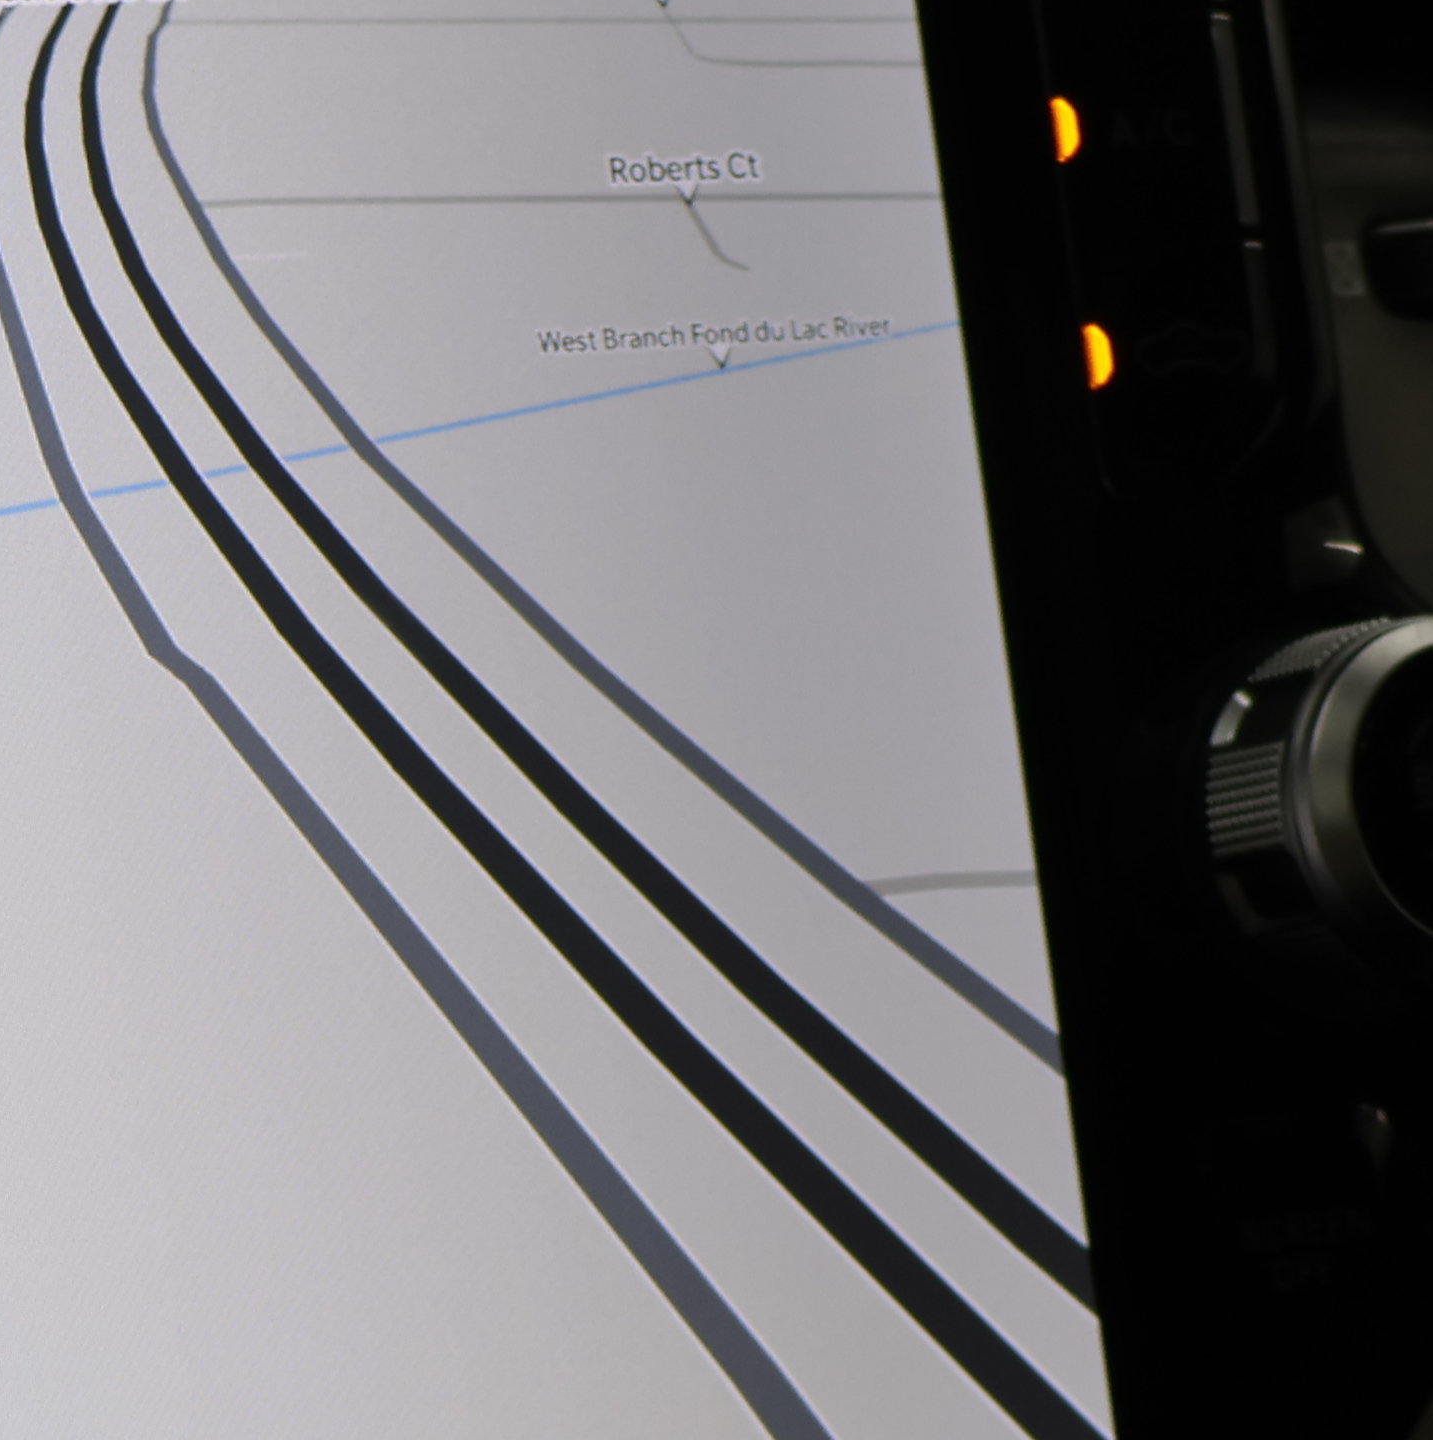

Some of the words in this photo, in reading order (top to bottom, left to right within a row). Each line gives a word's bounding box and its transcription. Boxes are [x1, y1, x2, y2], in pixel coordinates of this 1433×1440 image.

[609, 157, 721, 183] Roberts
[727, 152, 758, 179] Ct
[537, 331, 598, 353] West
[602, 325, 685, 350] Branch
[690, 322, 750, 345] Fond
[755, 321, 785, 343] du
[791, 320, 828, 341] Lac
[833, 316, 889, 337] River
